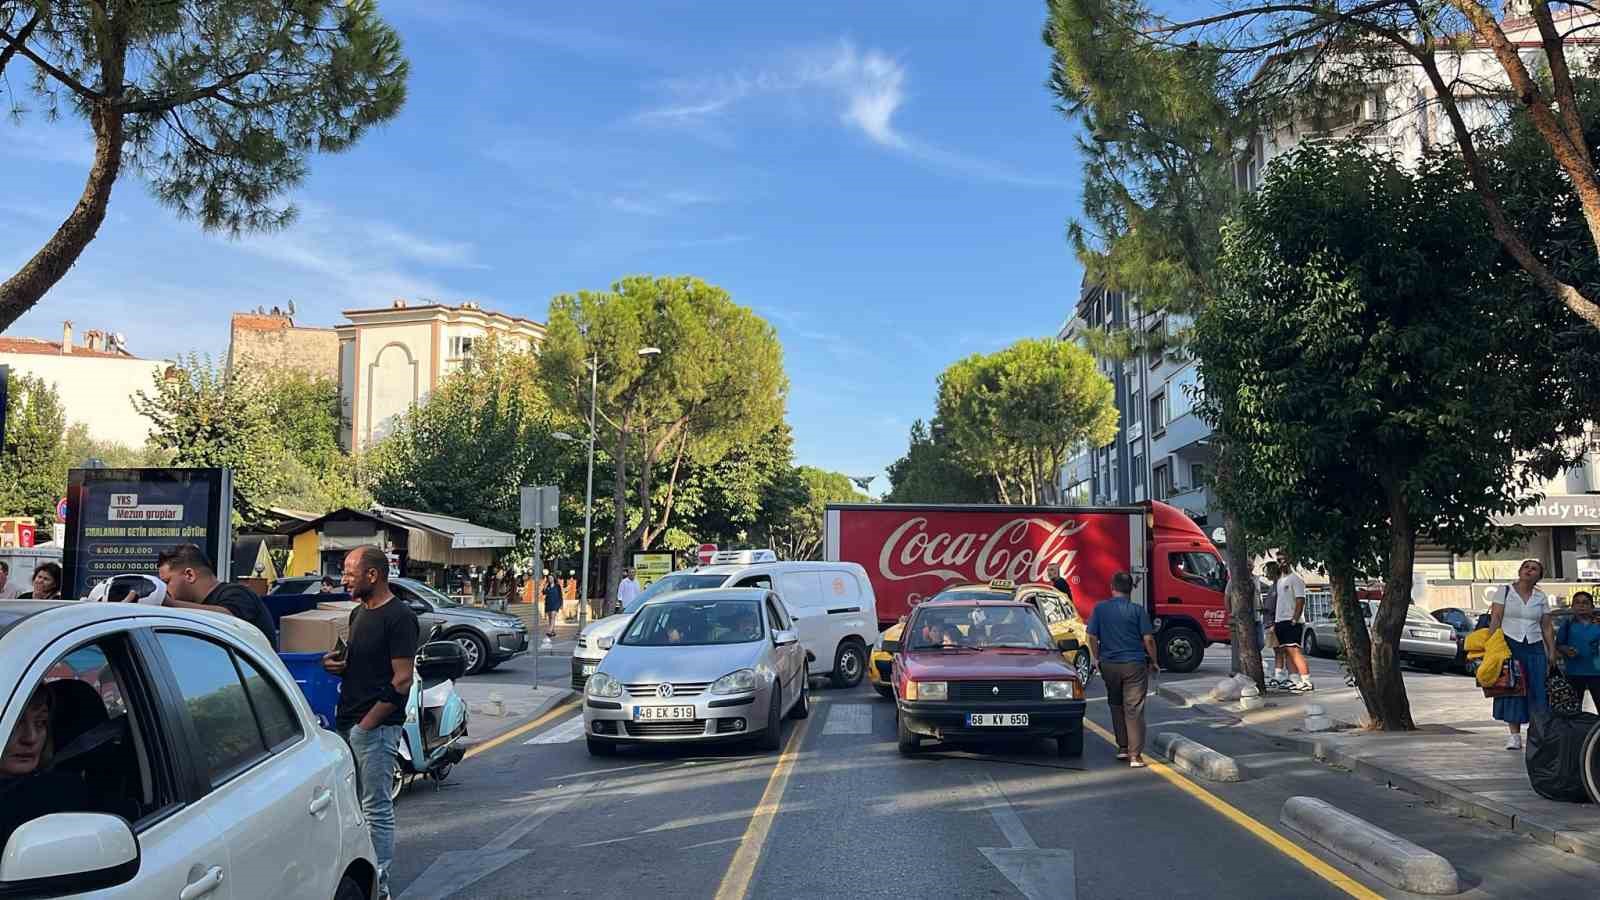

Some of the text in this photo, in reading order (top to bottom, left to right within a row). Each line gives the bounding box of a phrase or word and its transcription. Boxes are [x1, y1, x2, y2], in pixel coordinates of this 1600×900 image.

[117, 496, 131, 505] YKS
[146, 510, 176, 521] gruplar
[879, 517, 1088, 582] Coca-Cola
[656, 707, 669, 718] EK
[673, 707, 692, 718] 519
[1010, 714, 1027, 725] 650
